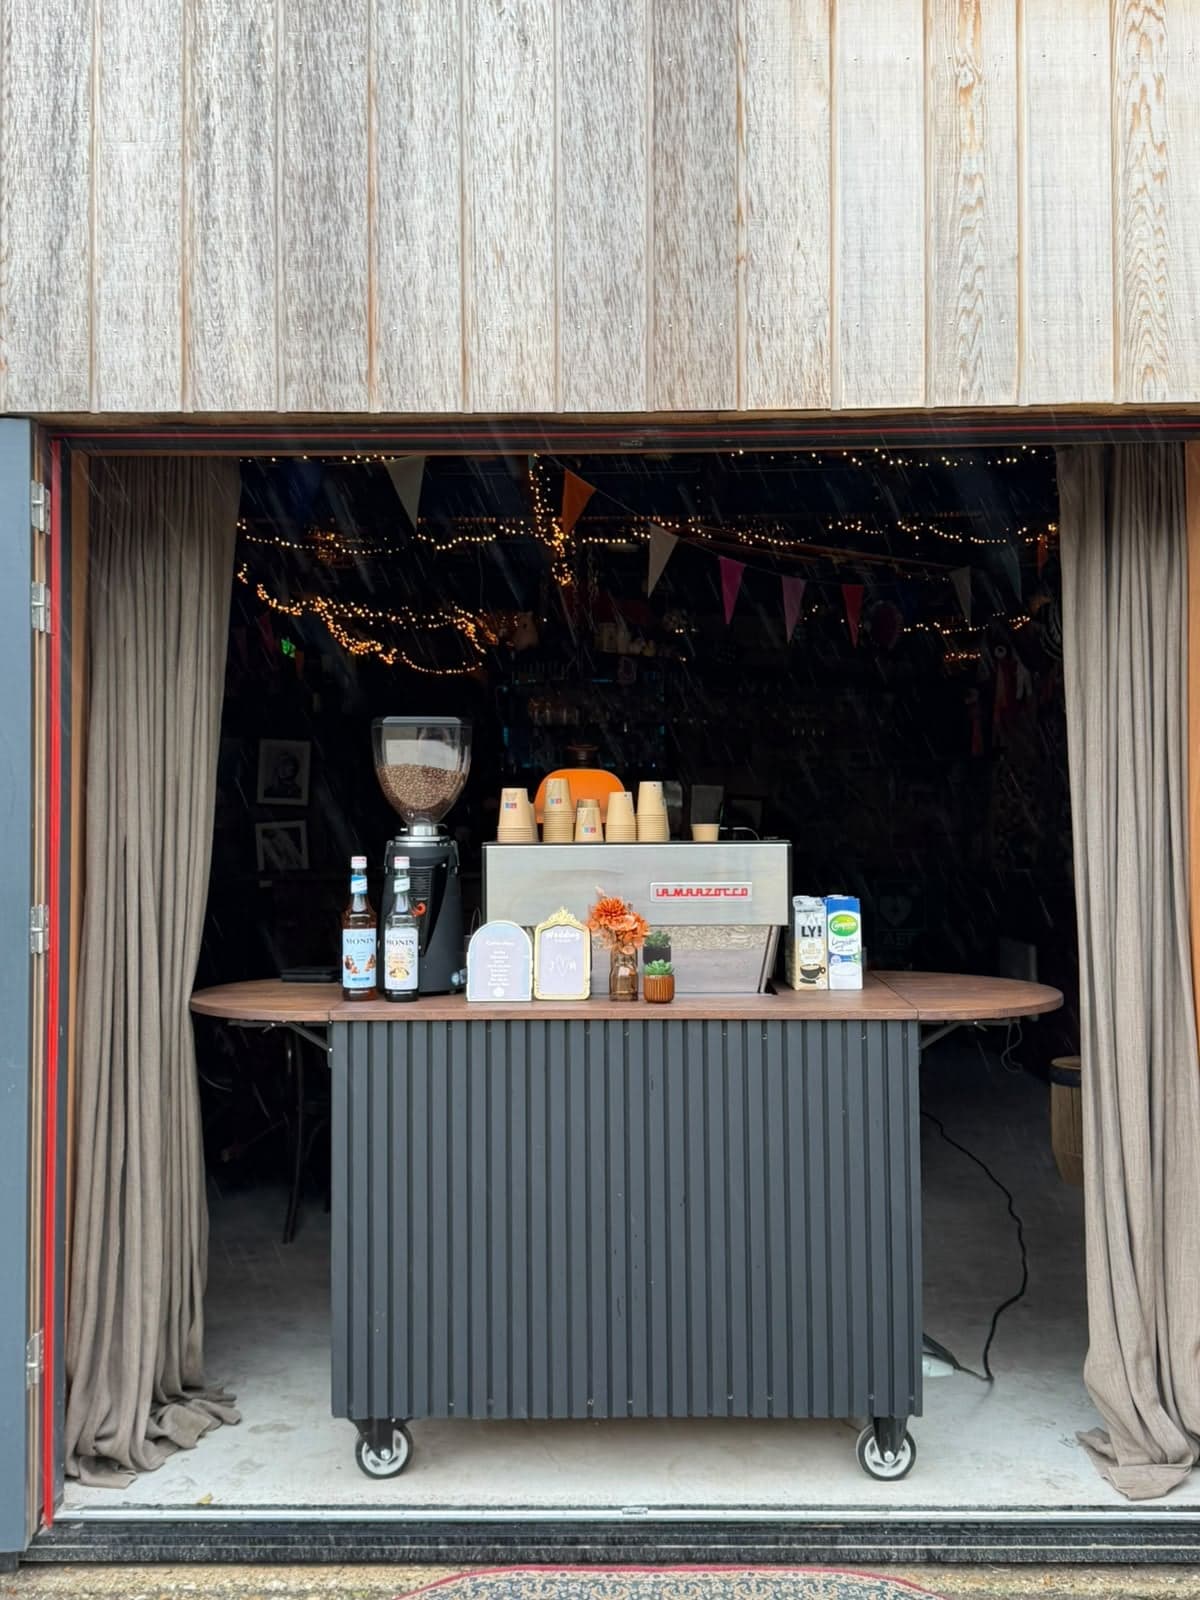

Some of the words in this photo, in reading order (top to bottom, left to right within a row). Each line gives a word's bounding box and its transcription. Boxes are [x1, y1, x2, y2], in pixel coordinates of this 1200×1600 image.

[672, 888, 749, 897] MARZOCCO
[801, 926, 822, 938] LY!
[345, 937, 374, 945] MONIN
